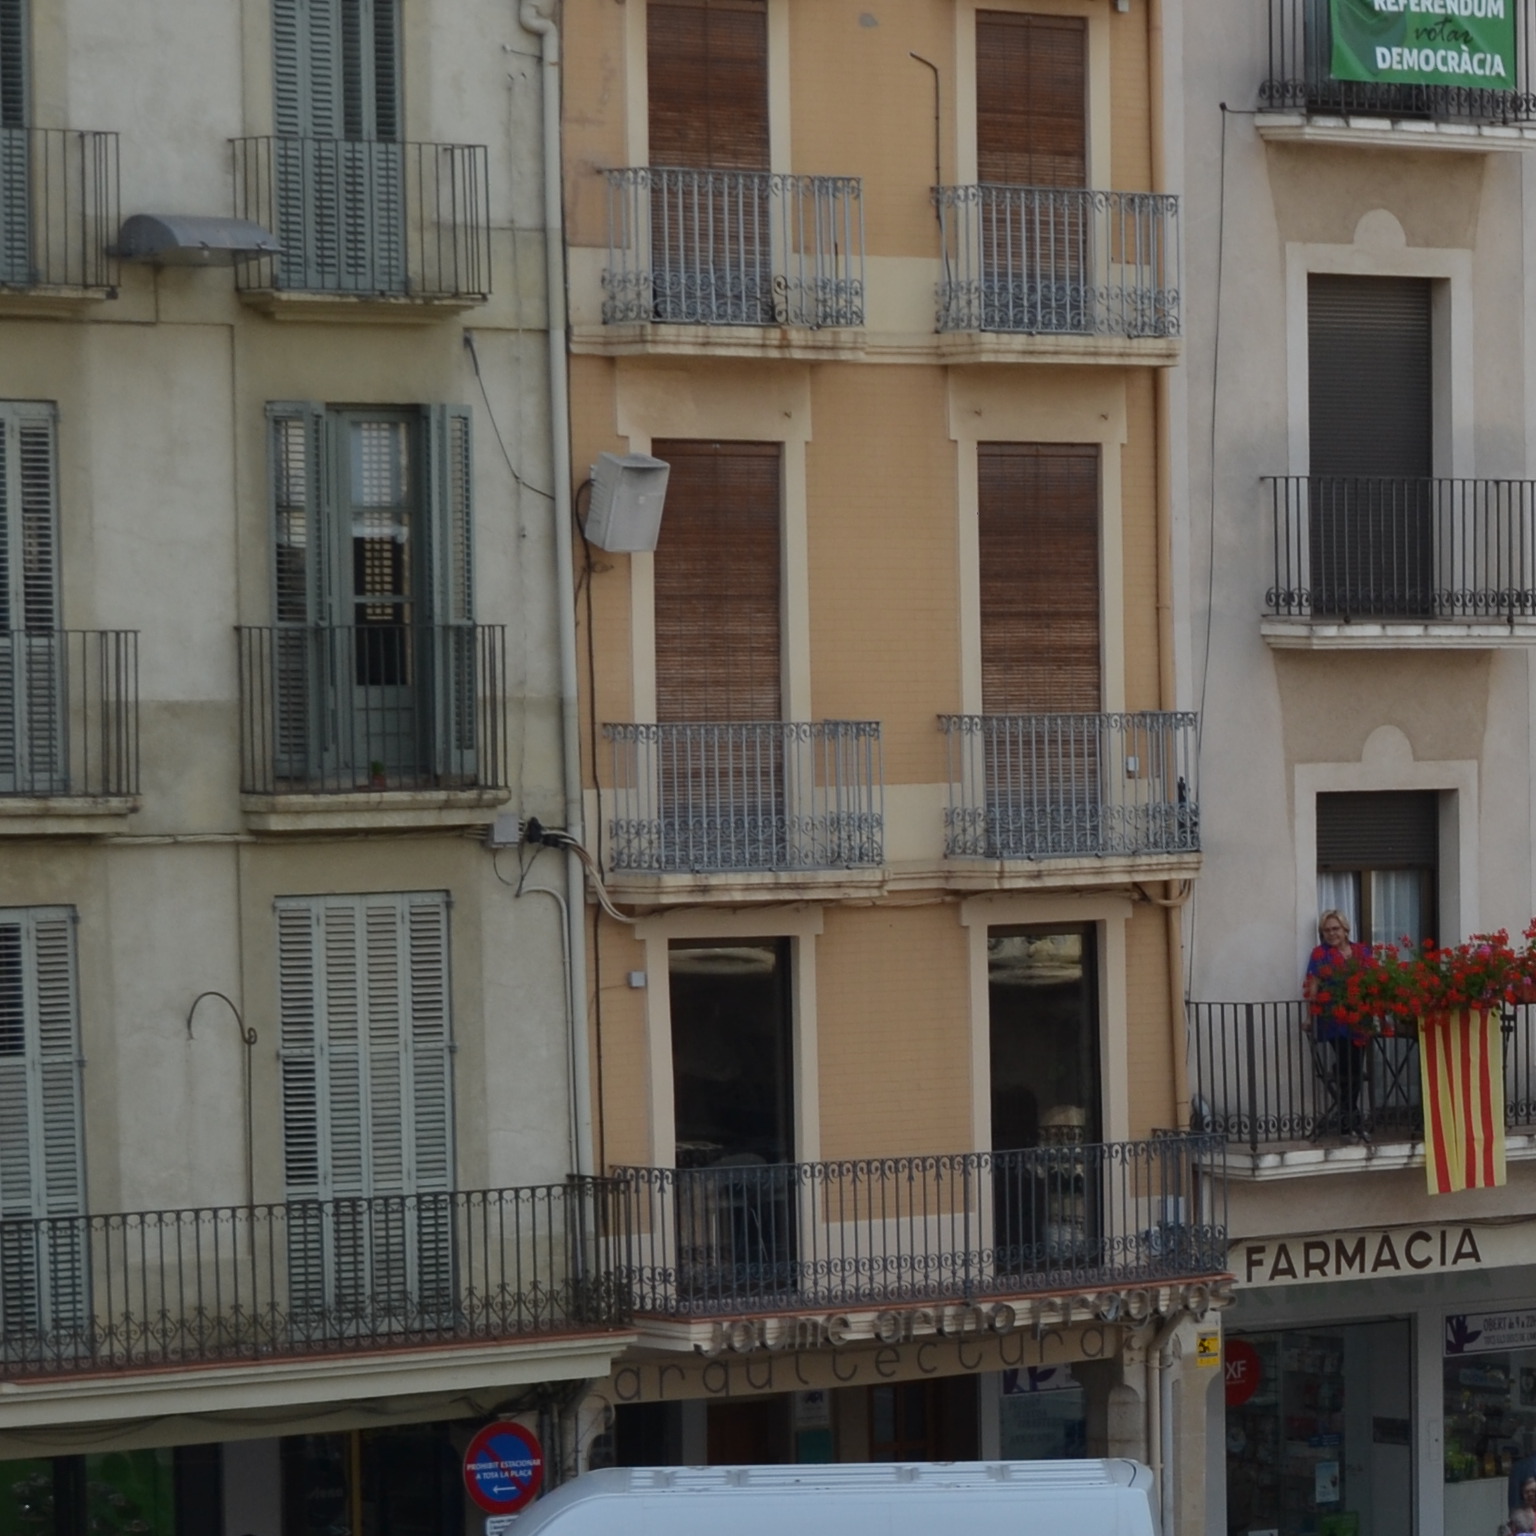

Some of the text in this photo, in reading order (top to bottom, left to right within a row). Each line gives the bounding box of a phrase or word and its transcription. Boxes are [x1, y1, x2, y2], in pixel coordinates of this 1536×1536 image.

[1415, 15, 1473, 44] votar
[1375, 44, 1506, 77] DEMOCRÀCIA
[612, 1325, 1108, 1401] arquitectura
[466, 1458, 542, 1471] PROHIBIT ESTACIONAR
